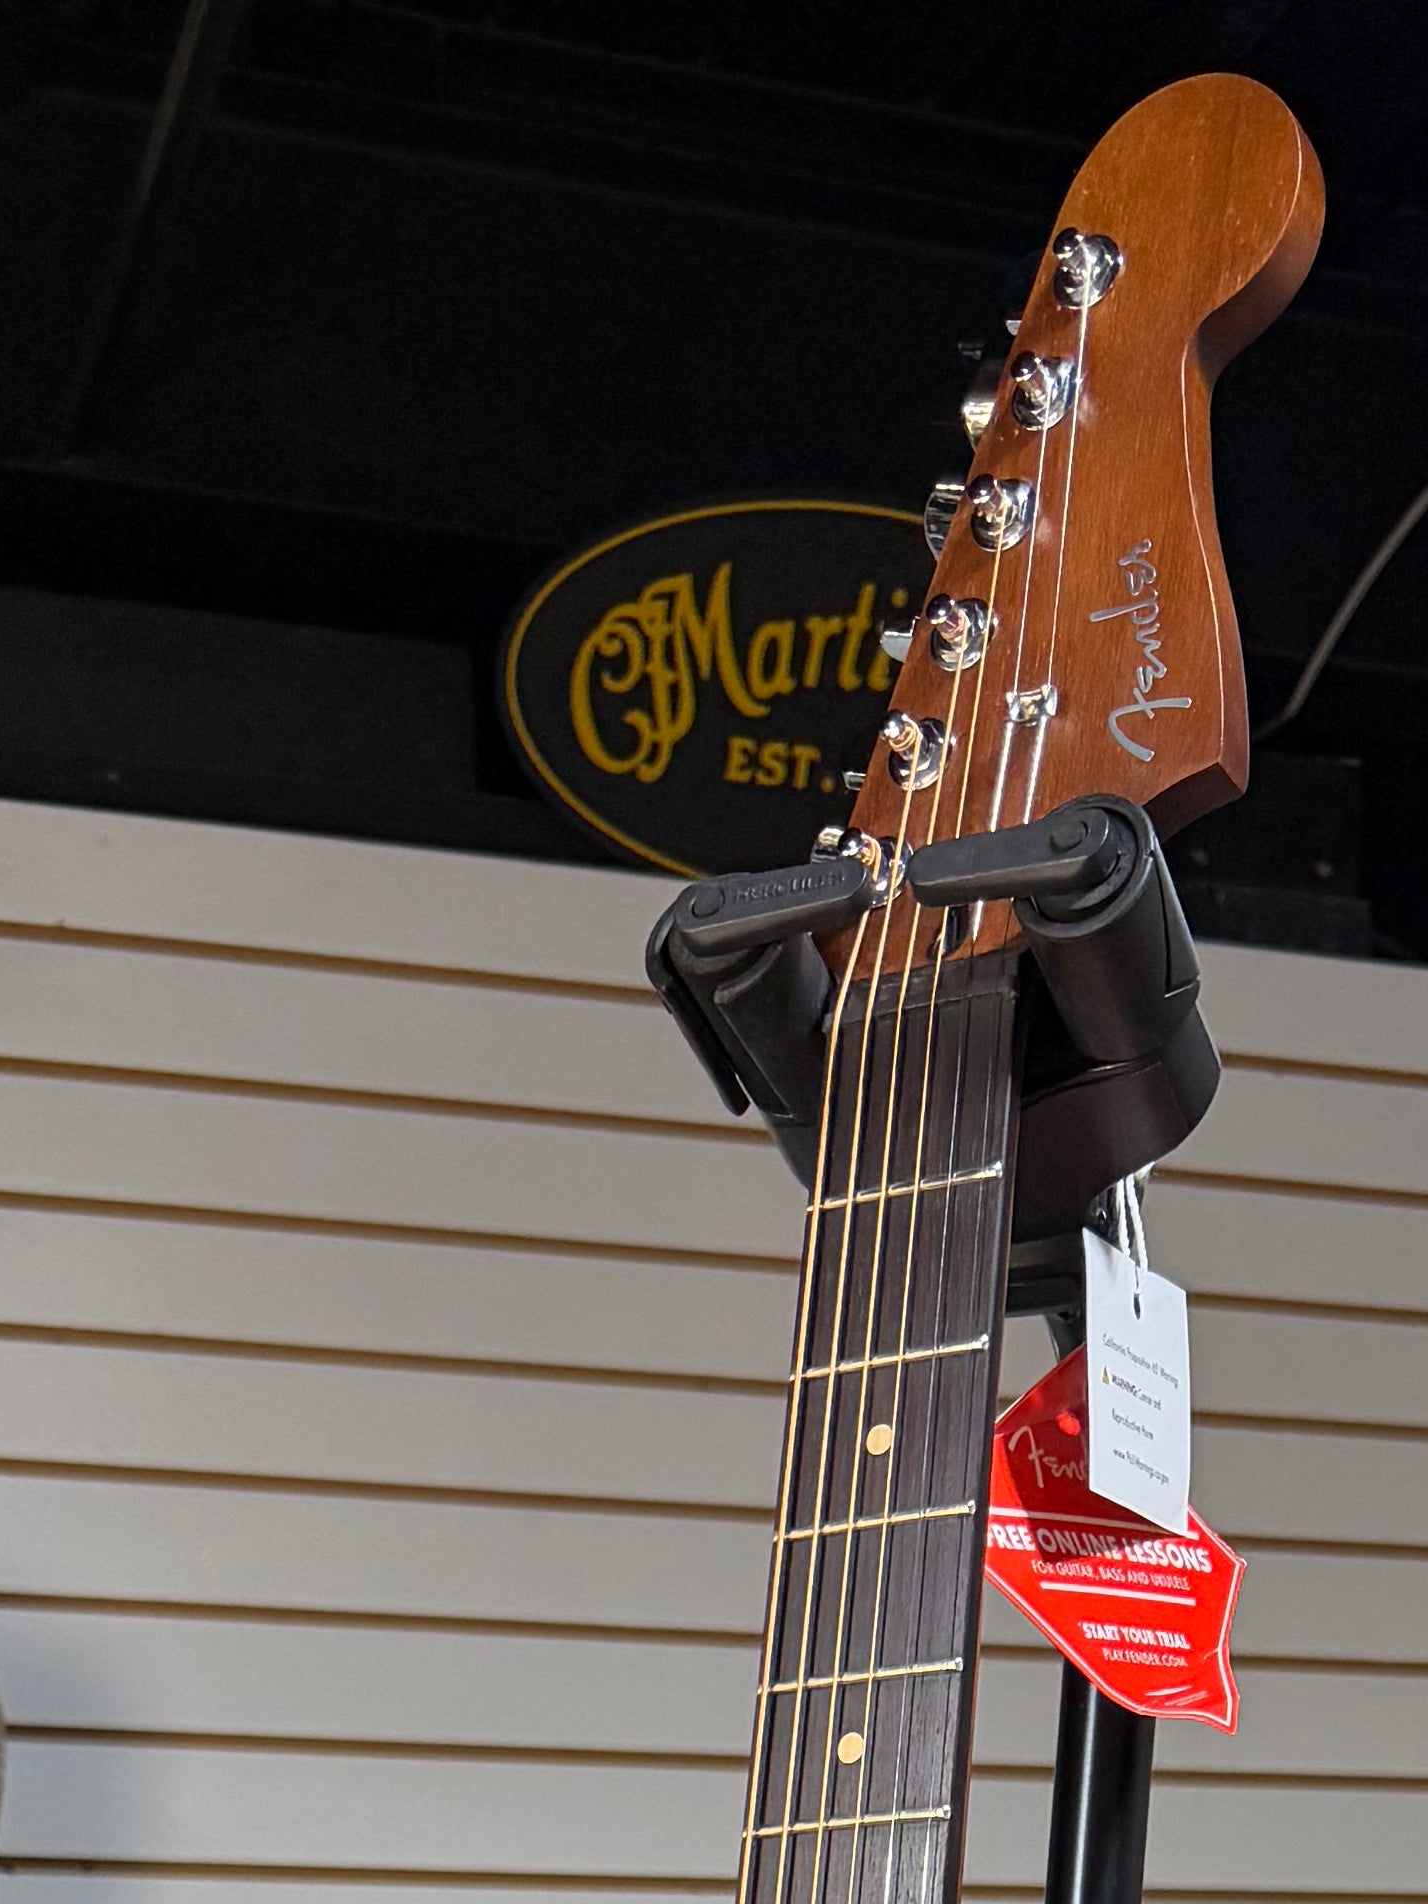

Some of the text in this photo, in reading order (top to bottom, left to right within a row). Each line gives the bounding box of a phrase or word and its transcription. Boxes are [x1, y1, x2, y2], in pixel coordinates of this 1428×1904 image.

[1089, 538, 1192, 762] Fender
[725, 736, 836, 794] EST.
[1008, 1425, 1086, 1489] Fen
[1037, 1527, 1123, 1561] ONLINE
[1123, 1538, 1213, 1574] LESSONS
[1121, 1627, 1155, 1645] YOUR
[1155, 1630, 1191, 1650] TRIAL
